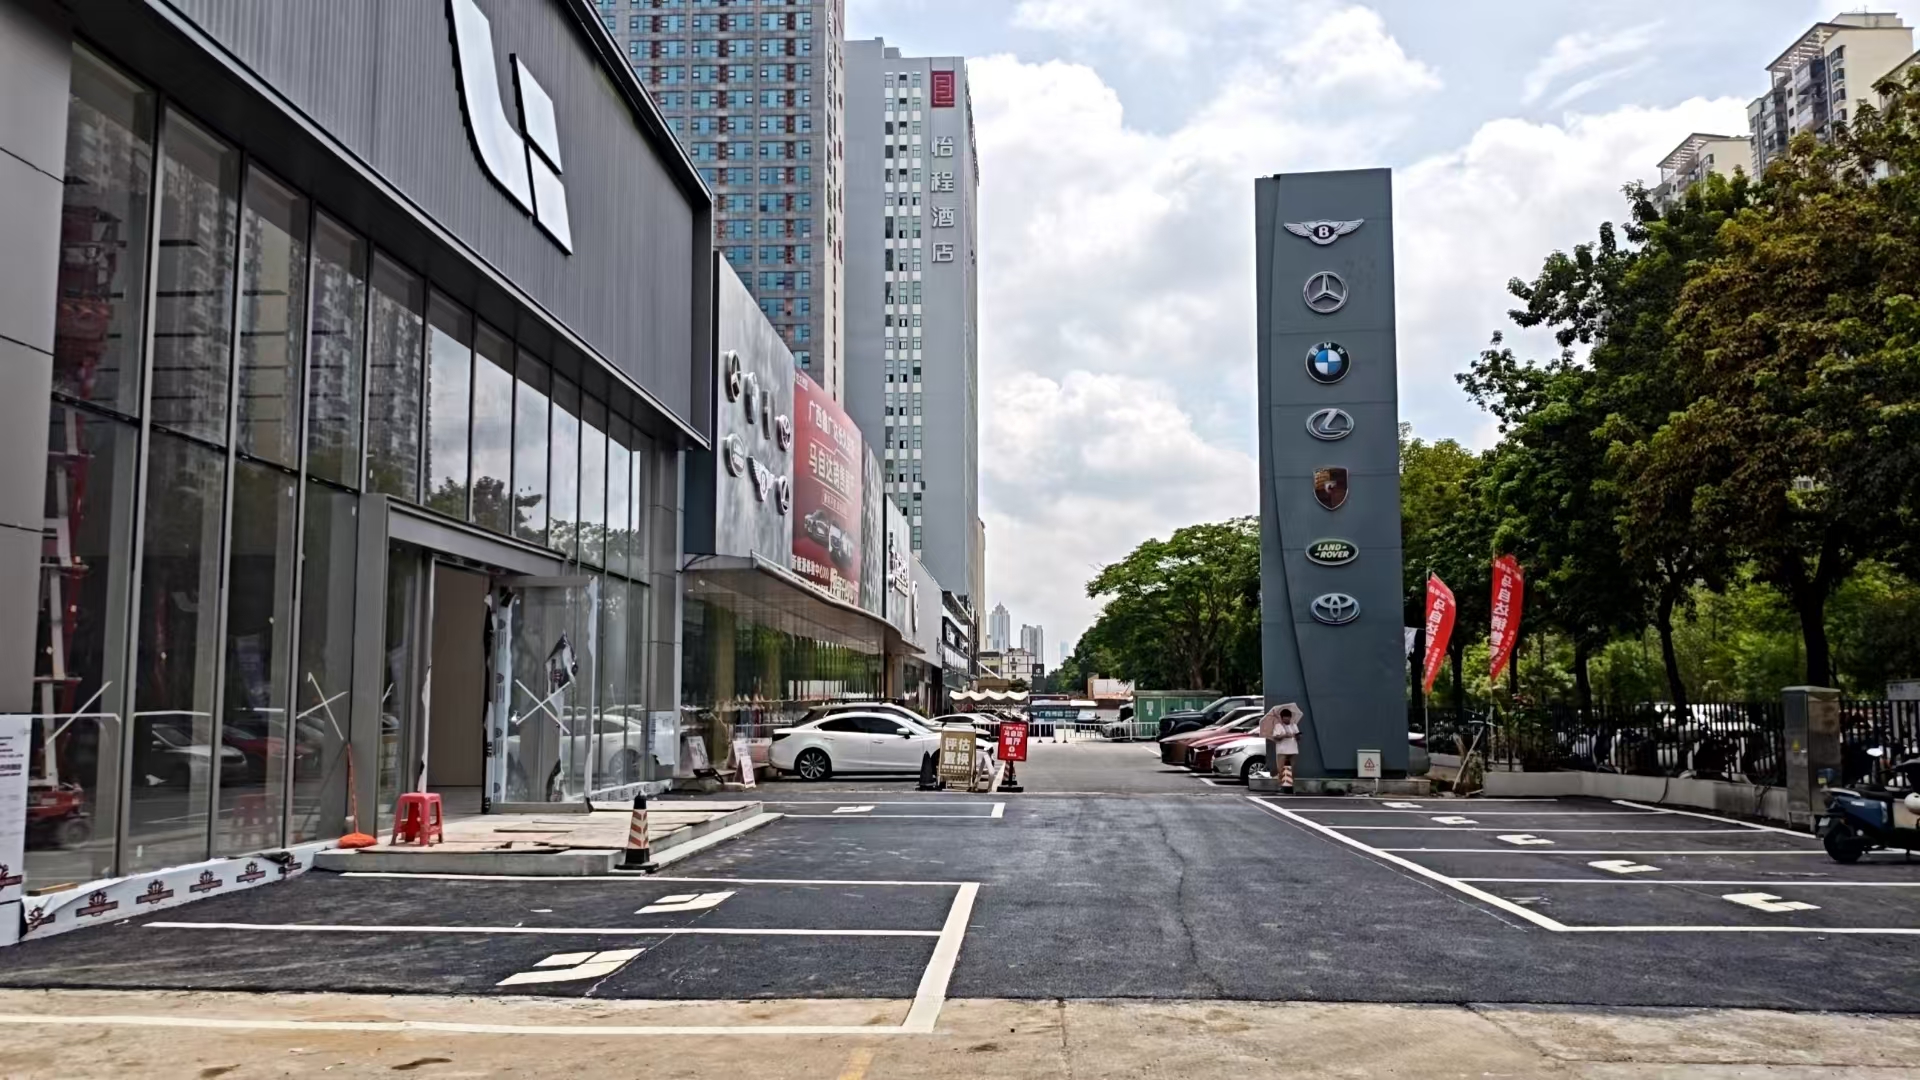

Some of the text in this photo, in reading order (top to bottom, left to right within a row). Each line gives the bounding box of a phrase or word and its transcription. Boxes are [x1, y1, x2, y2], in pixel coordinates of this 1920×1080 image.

[931, 136, 954, 263] 怡程酒店
[1318, 226, 1330, 238] B
[1310, 342, 1346, 356] BMW
[945, 737, 971, 751] 评估
